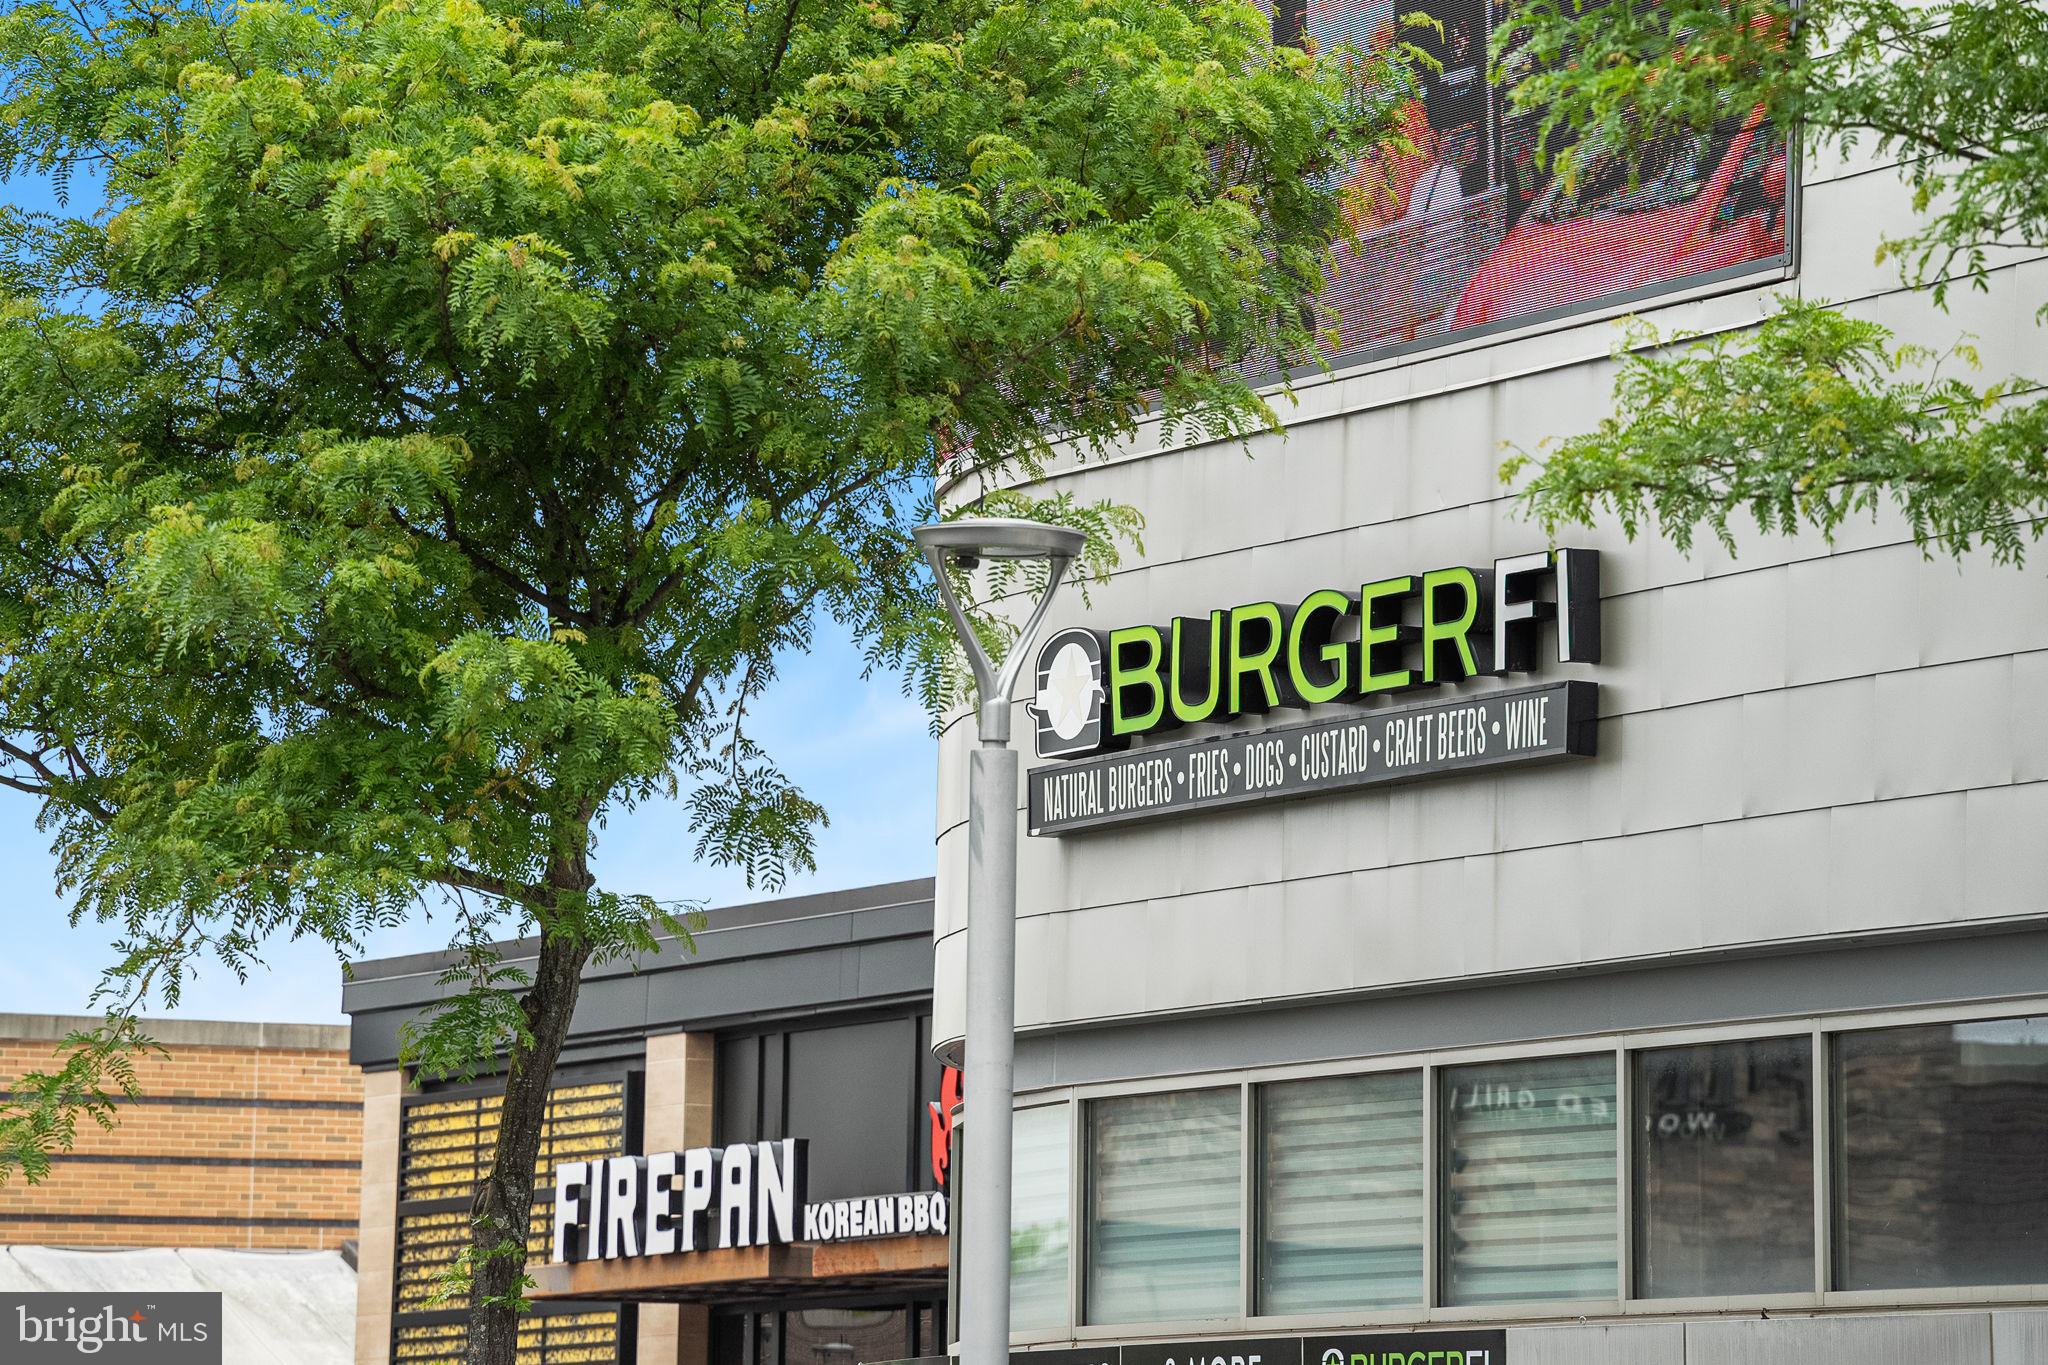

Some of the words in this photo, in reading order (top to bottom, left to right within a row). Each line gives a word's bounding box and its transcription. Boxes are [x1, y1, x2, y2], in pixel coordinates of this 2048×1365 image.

[1109, 548, 1571, 736] BURGERFI
[1043, 769, 1104, 822] NATURAL
[1108, 757, 1172, 812] BURGERS
[1188, 748, 1229, 800] FRIES
[1245, 739, 1284, 790] DOGS
[1301, 724, 1368, 781] CUSTARD
[1385, 714, 1433, 768] CRAFT
[1437, 706, 1487, 760] BEERS
[1505, 696, 1549, 750] WINE
[553, 1138, 795, 1263] FIREPAN
[803, 1197, 895, 1241] KOREAN
[898, 1191, 948, 1236] BBQ
